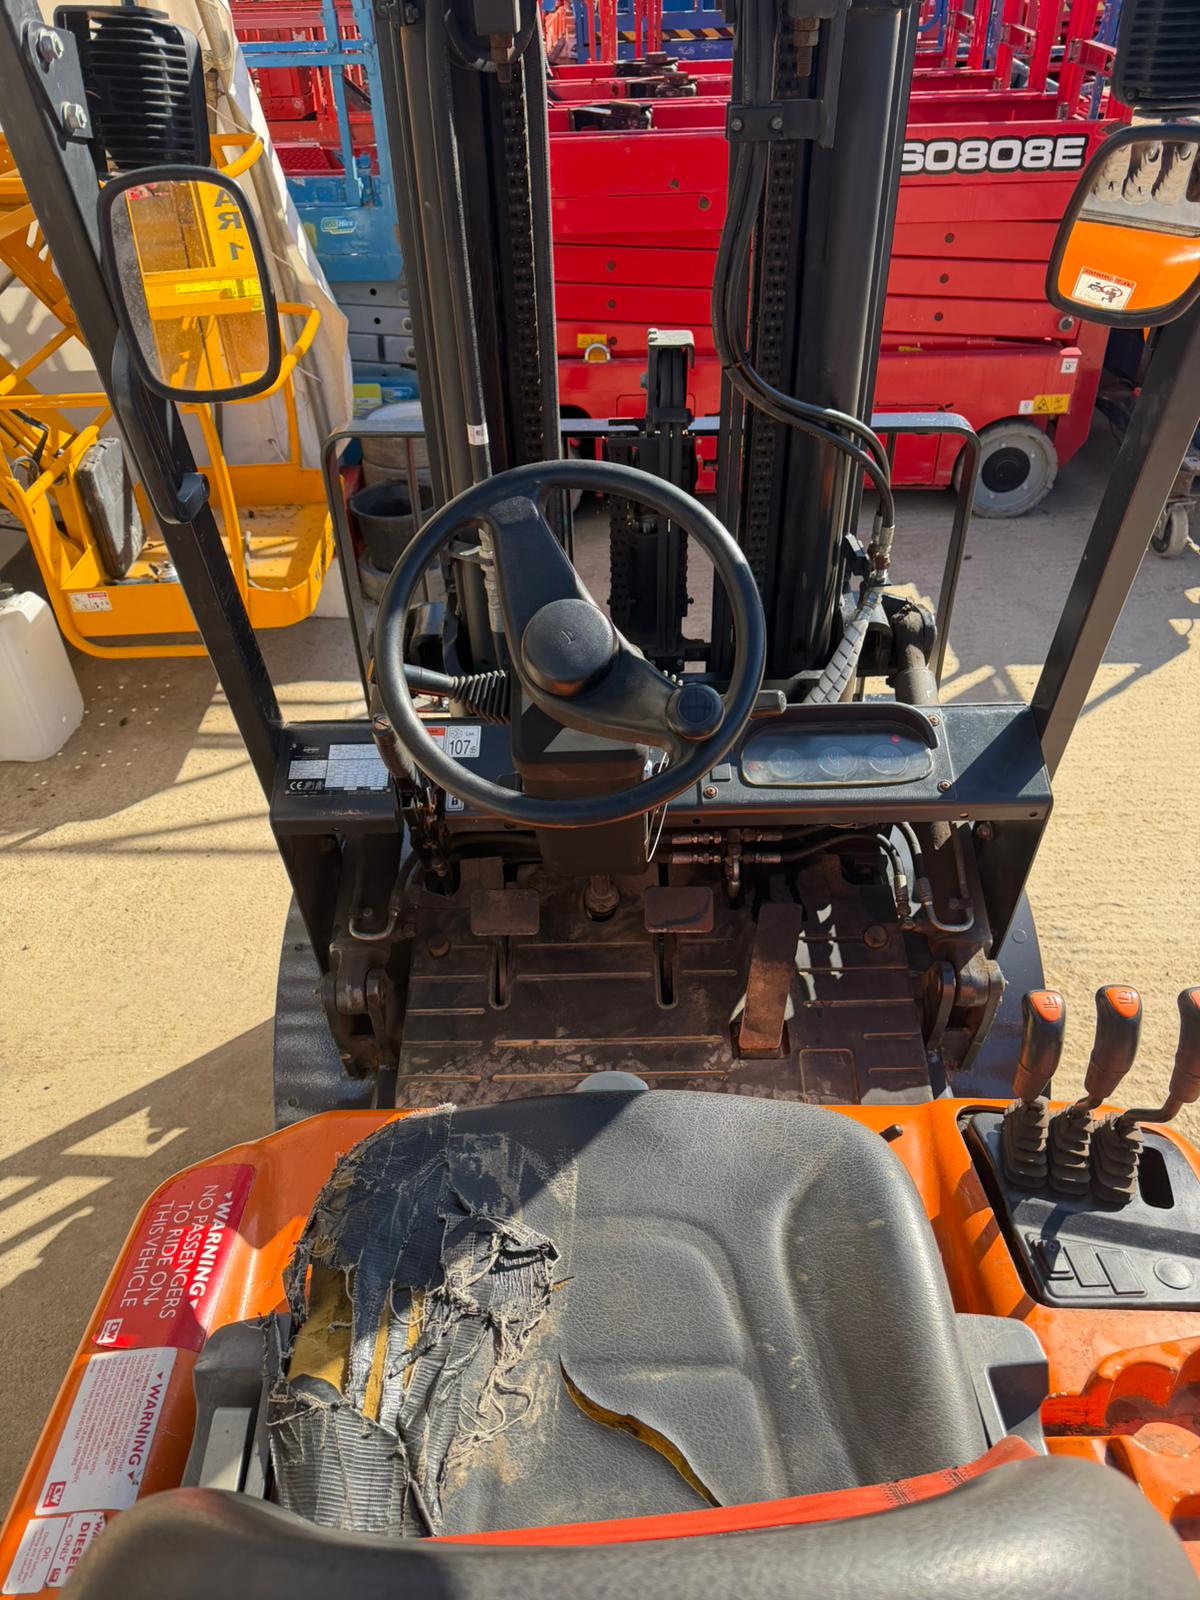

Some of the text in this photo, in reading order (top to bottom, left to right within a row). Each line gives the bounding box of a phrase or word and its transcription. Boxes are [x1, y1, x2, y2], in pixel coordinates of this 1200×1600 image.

[450, 740, 471, 755] 107
[290, 781, 304, 790] CE
[171, 1200, 194, 1223] TO
[118, 1199, 175, 1308] THIS VEHICLE
[155, 1228, 183, 1266] RIDE
[157, 1184, 219, 1319] NO PASSENGERS
[187, 1201, 232, 1296] WARNING
[127, 1383, 162, 1466] WARNING
[40, 1546, 52, 1561] OIL
[57, 1534, 74, 1561] ONLY
[64, 1521, 91, 1573] DIESEL
